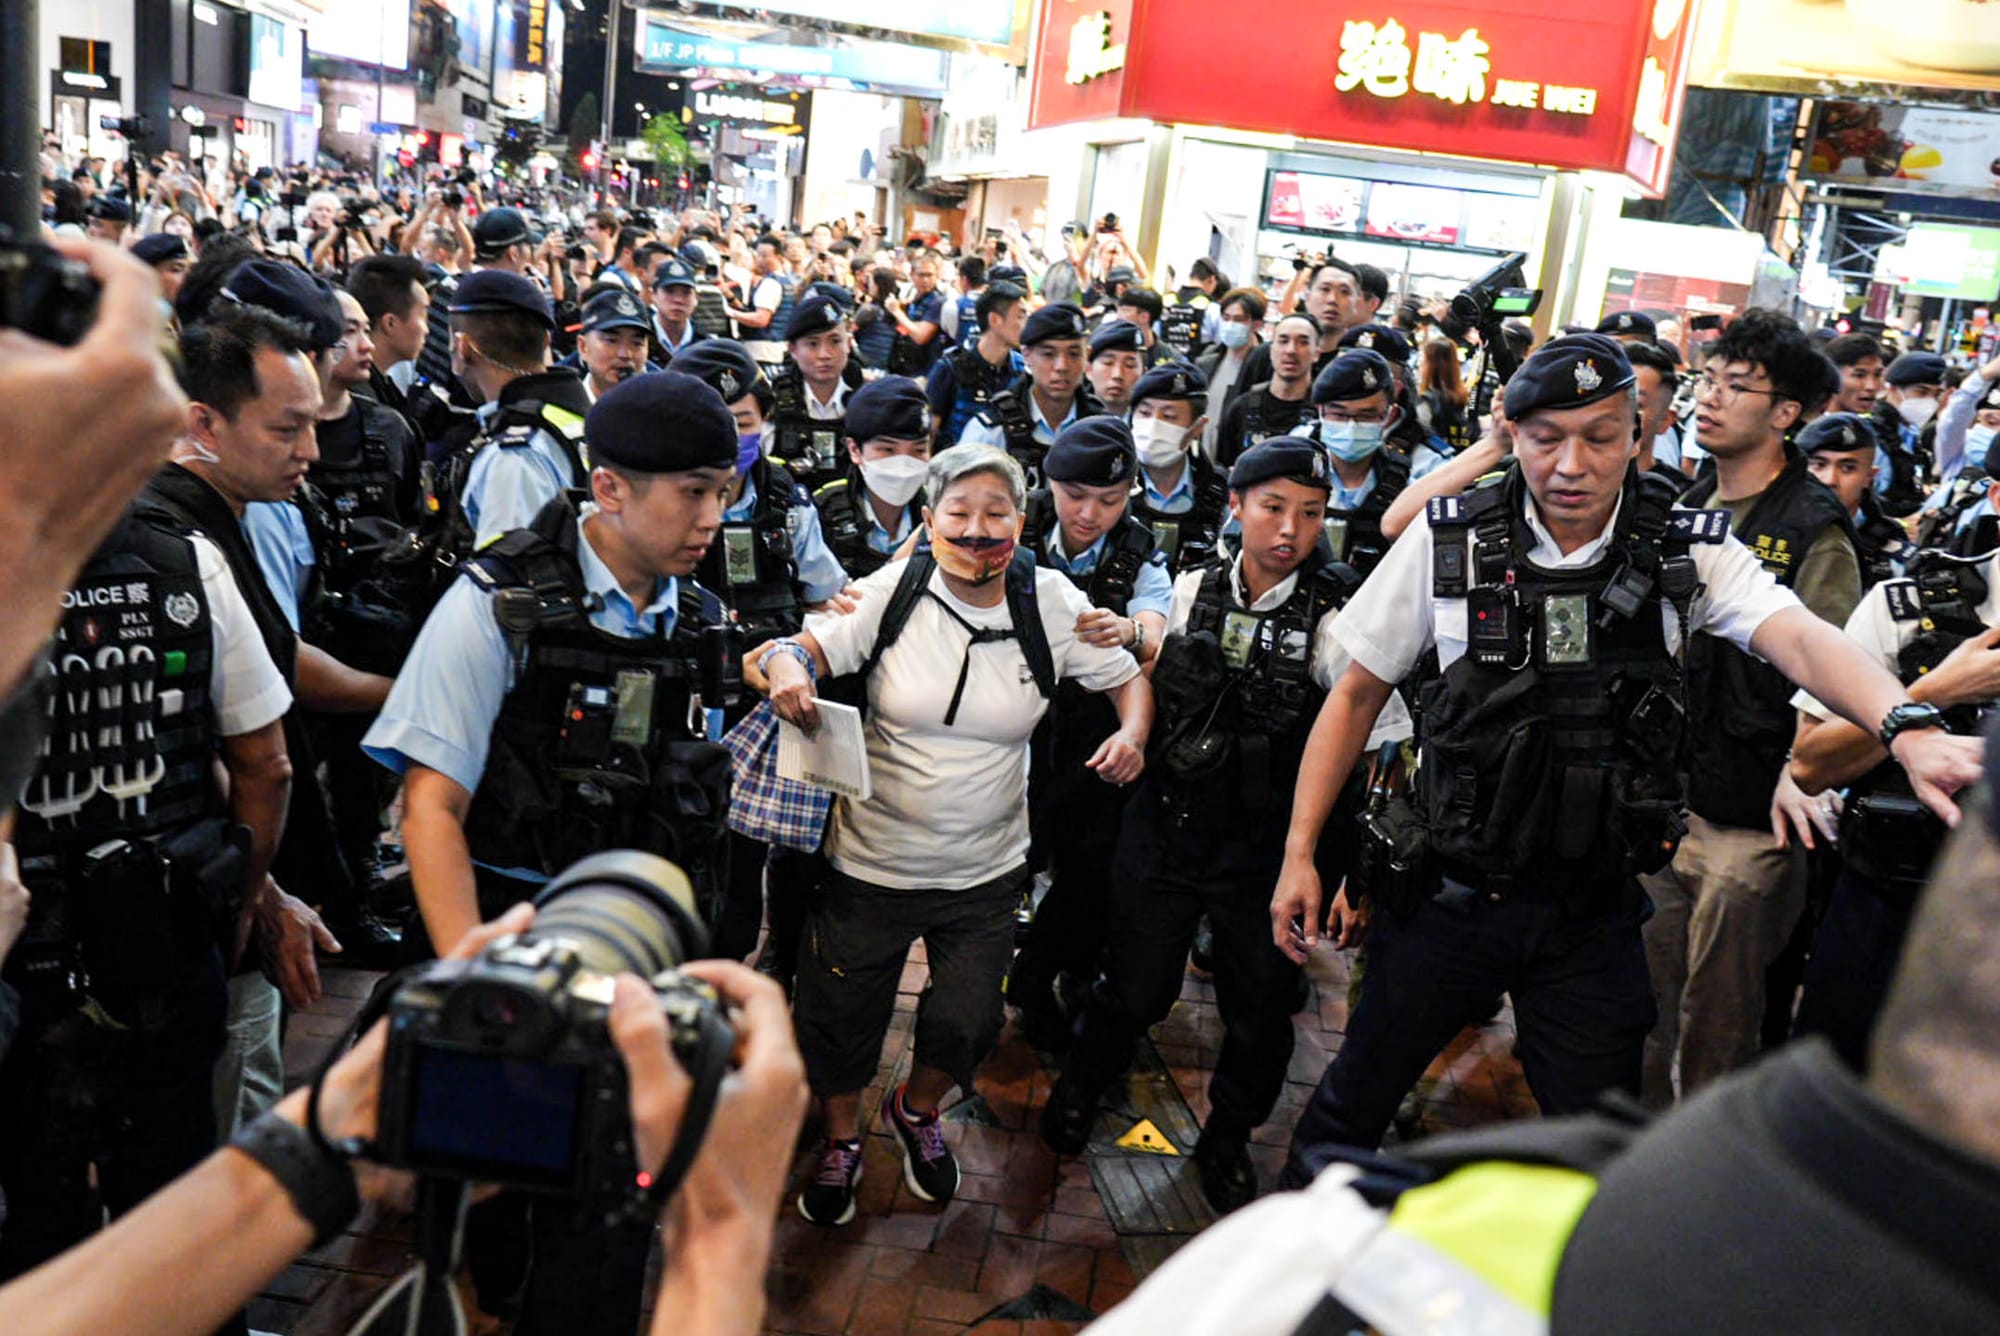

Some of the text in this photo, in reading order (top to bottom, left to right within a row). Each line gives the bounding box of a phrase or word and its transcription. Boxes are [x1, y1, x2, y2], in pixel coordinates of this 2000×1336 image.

[1490, 79, 1597, 115] JUE WEI
[59, 586, 125, 608] OLICE
